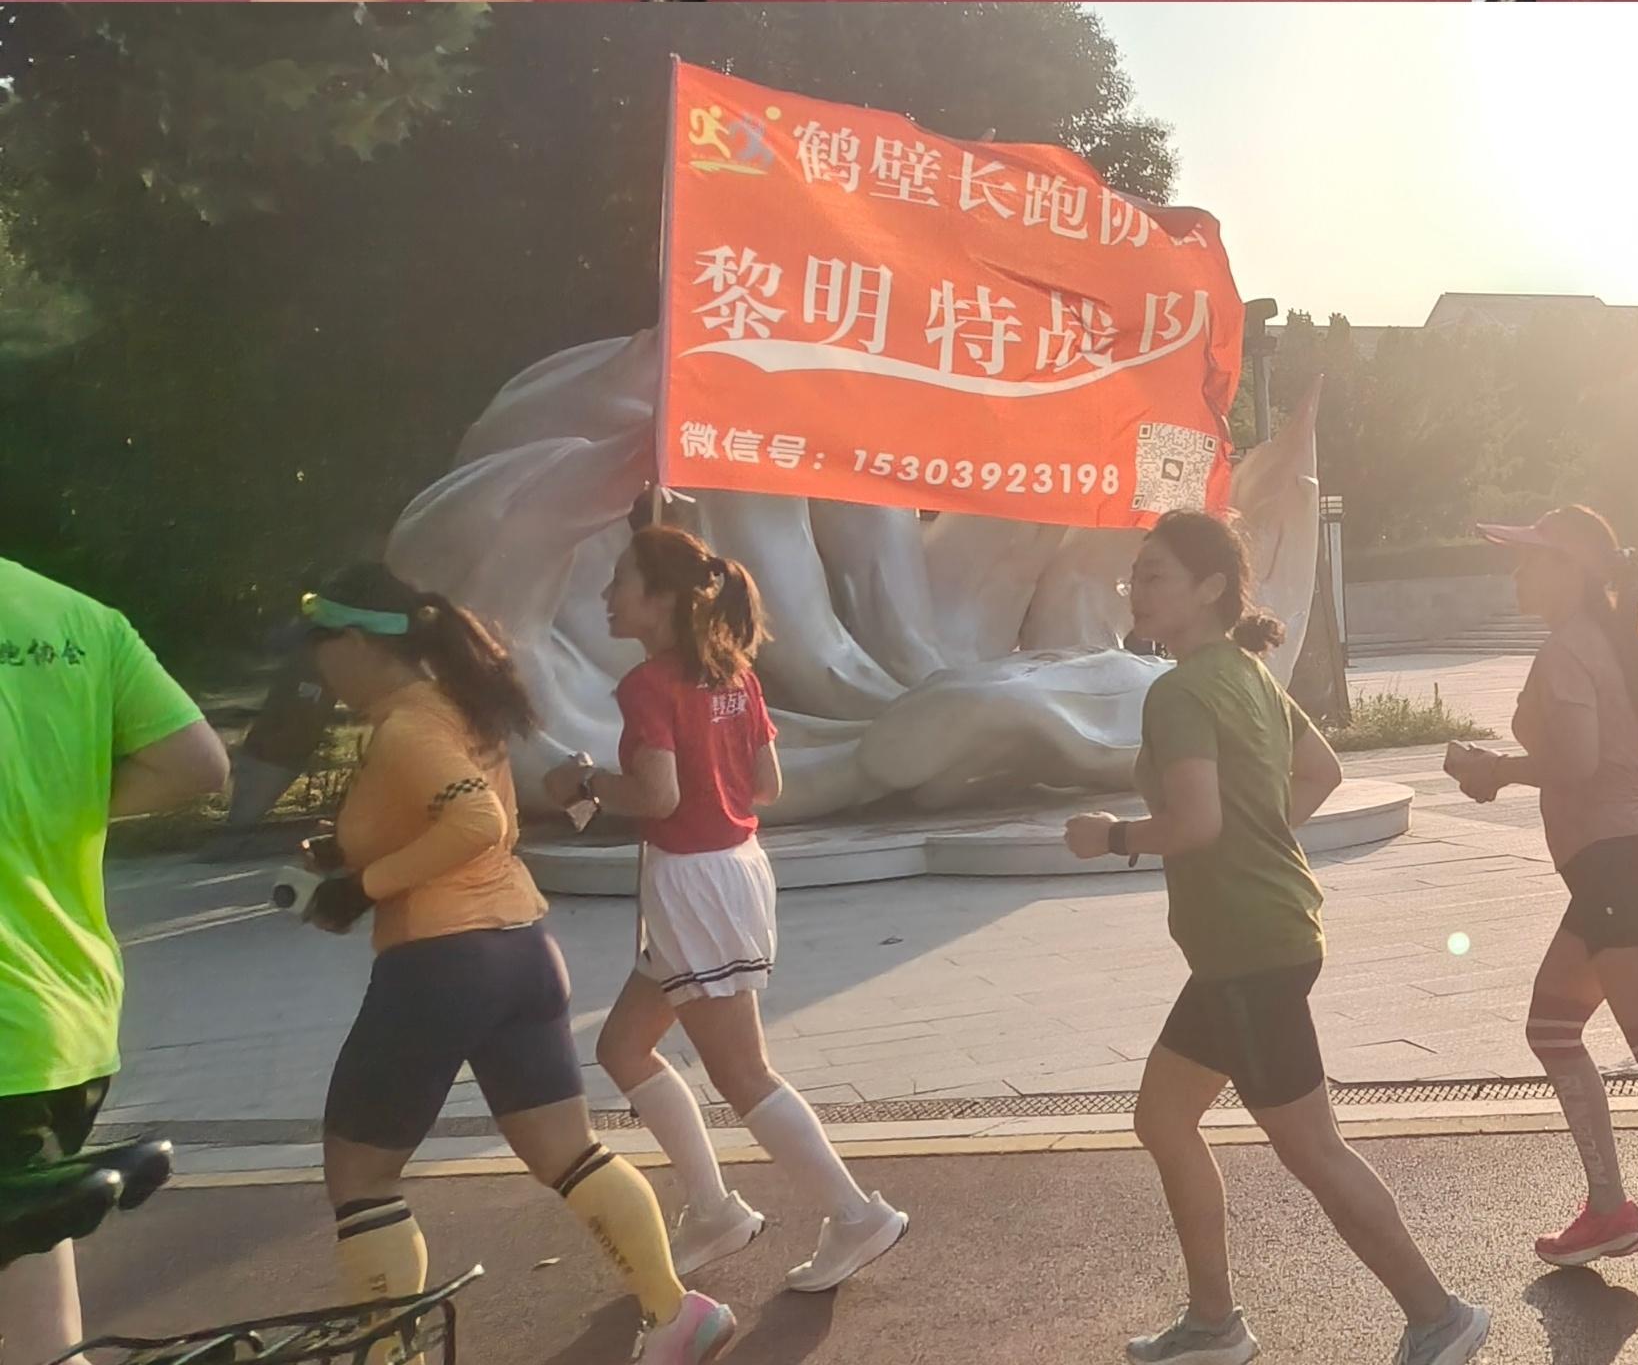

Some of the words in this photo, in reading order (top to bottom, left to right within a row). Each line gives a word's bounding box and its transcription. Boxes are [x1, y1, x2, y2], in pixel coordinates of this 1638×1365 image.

[691, 244, 1210, 377] 黎明特战队
[852, 449, 1120, 496] 15303923198
